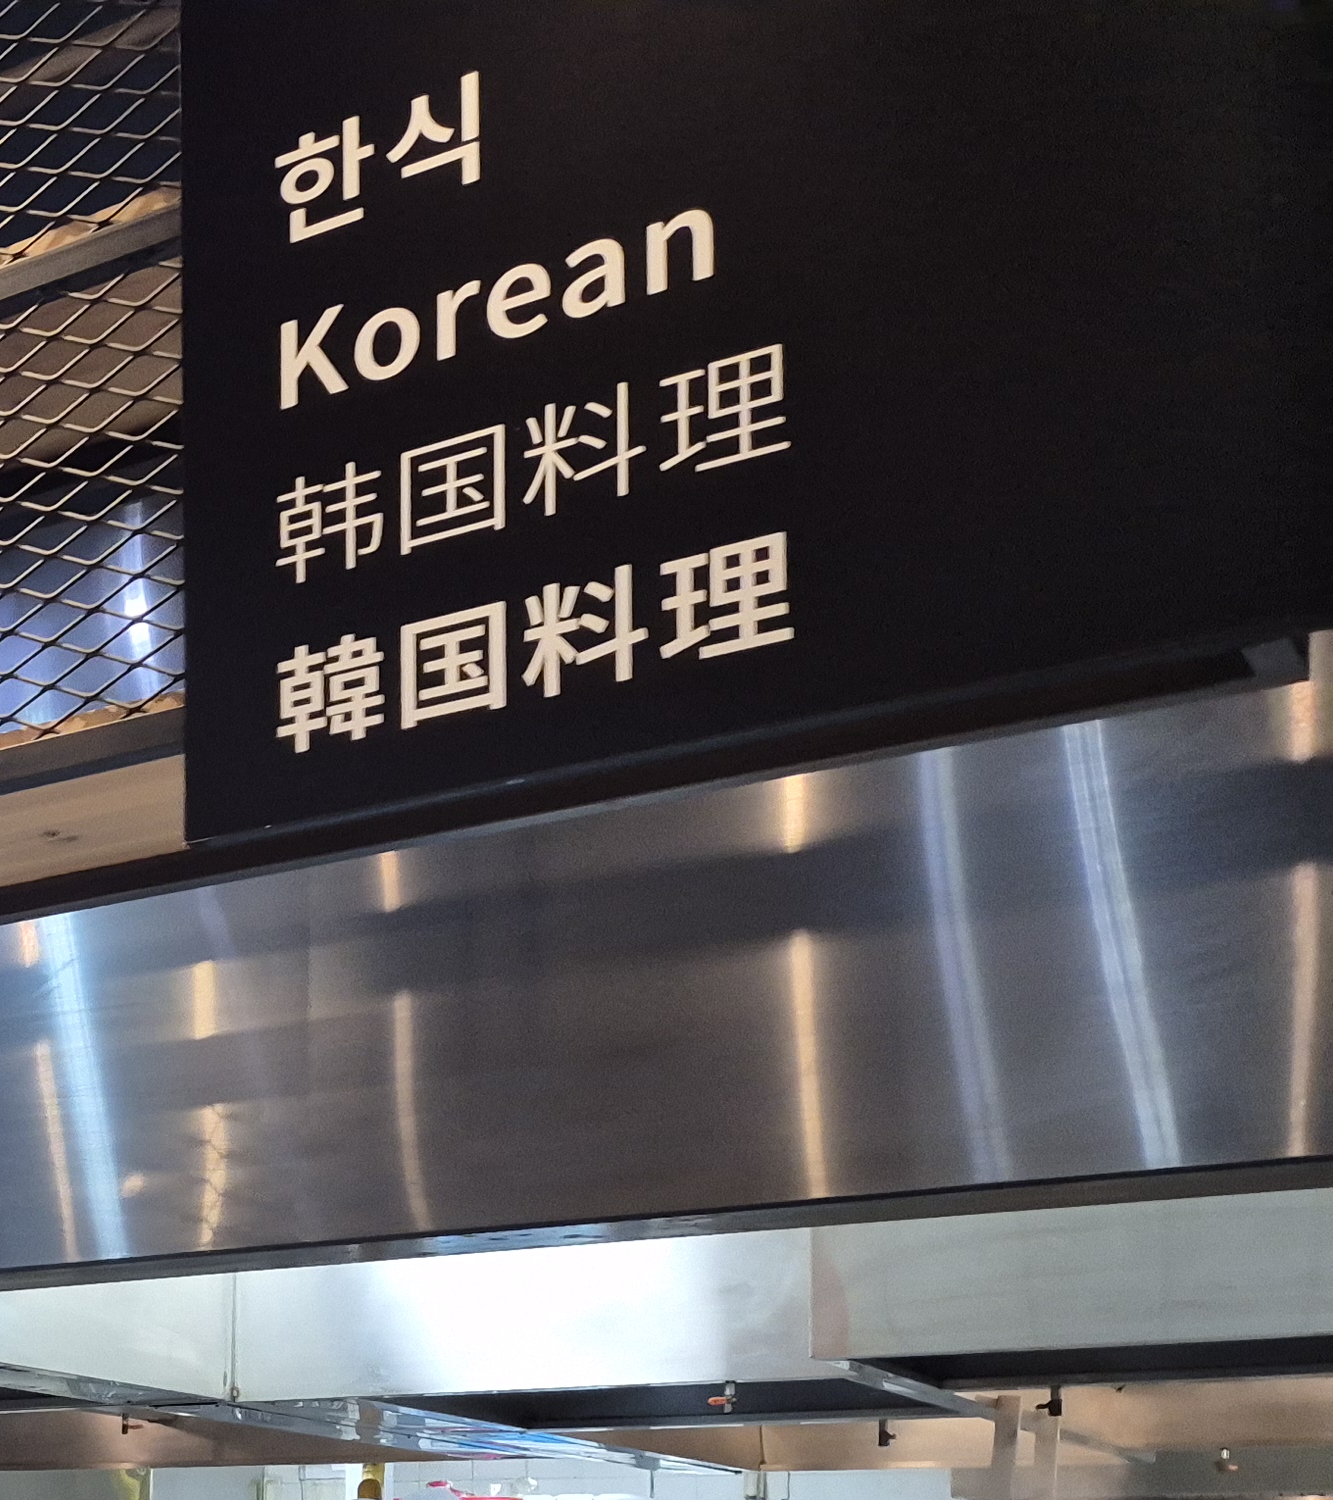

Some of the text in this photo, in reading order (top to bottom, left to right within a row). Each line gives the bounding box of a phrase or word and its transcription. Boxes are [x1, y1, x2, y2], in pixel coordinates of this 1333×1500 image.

[275, 70, 480, 243] 한식
[279, 208, 715, 411] Korean
[276, 343, 791, 584] 韩国料理
[276, 531, 795, 753] 韓国料理
